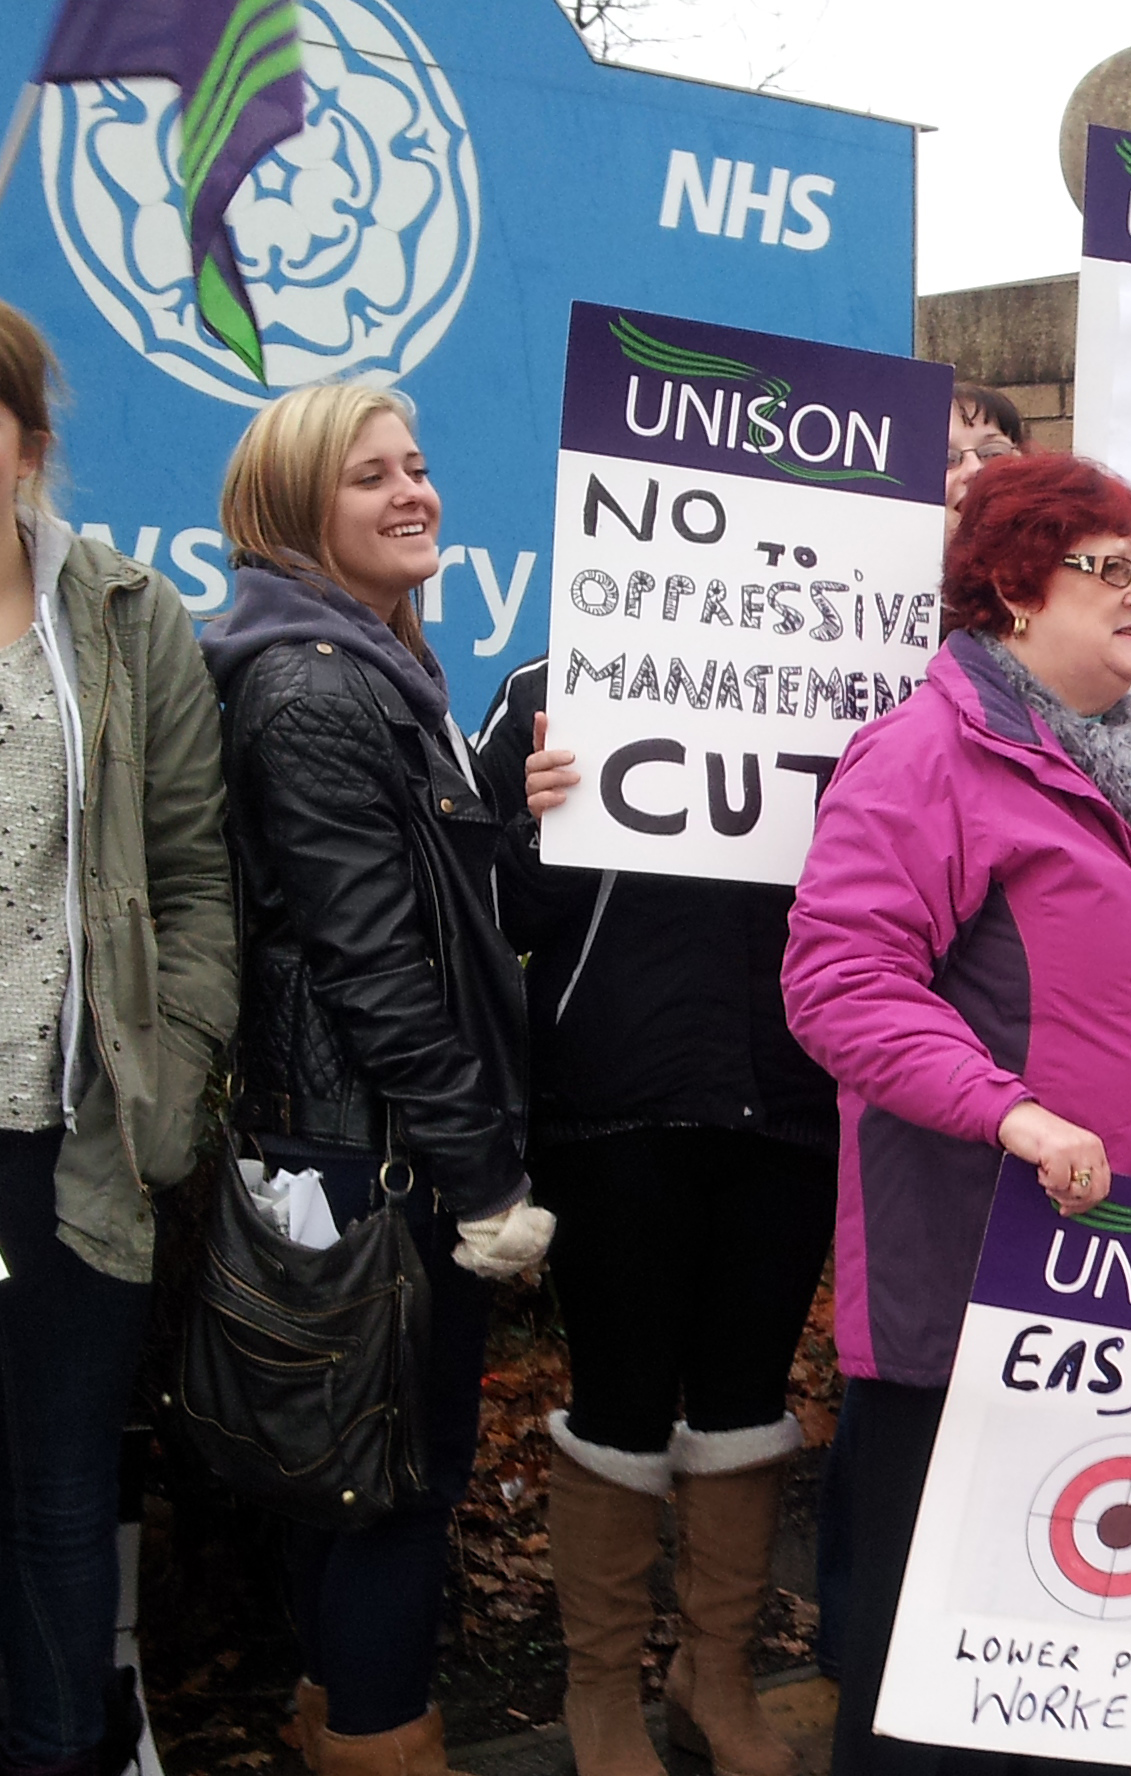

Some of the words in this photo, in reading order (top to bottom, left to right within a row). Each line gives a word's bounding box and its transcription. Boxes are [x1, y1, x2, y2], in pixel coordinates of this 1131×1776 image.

[659, 149, 836, 251] NHS
[625, 375, 891, 472] UNISON
[583, 472, 727, 544] NO
[755, 541, 818, 569] TO
[955, 1628, 1080, 1673] LOWER
